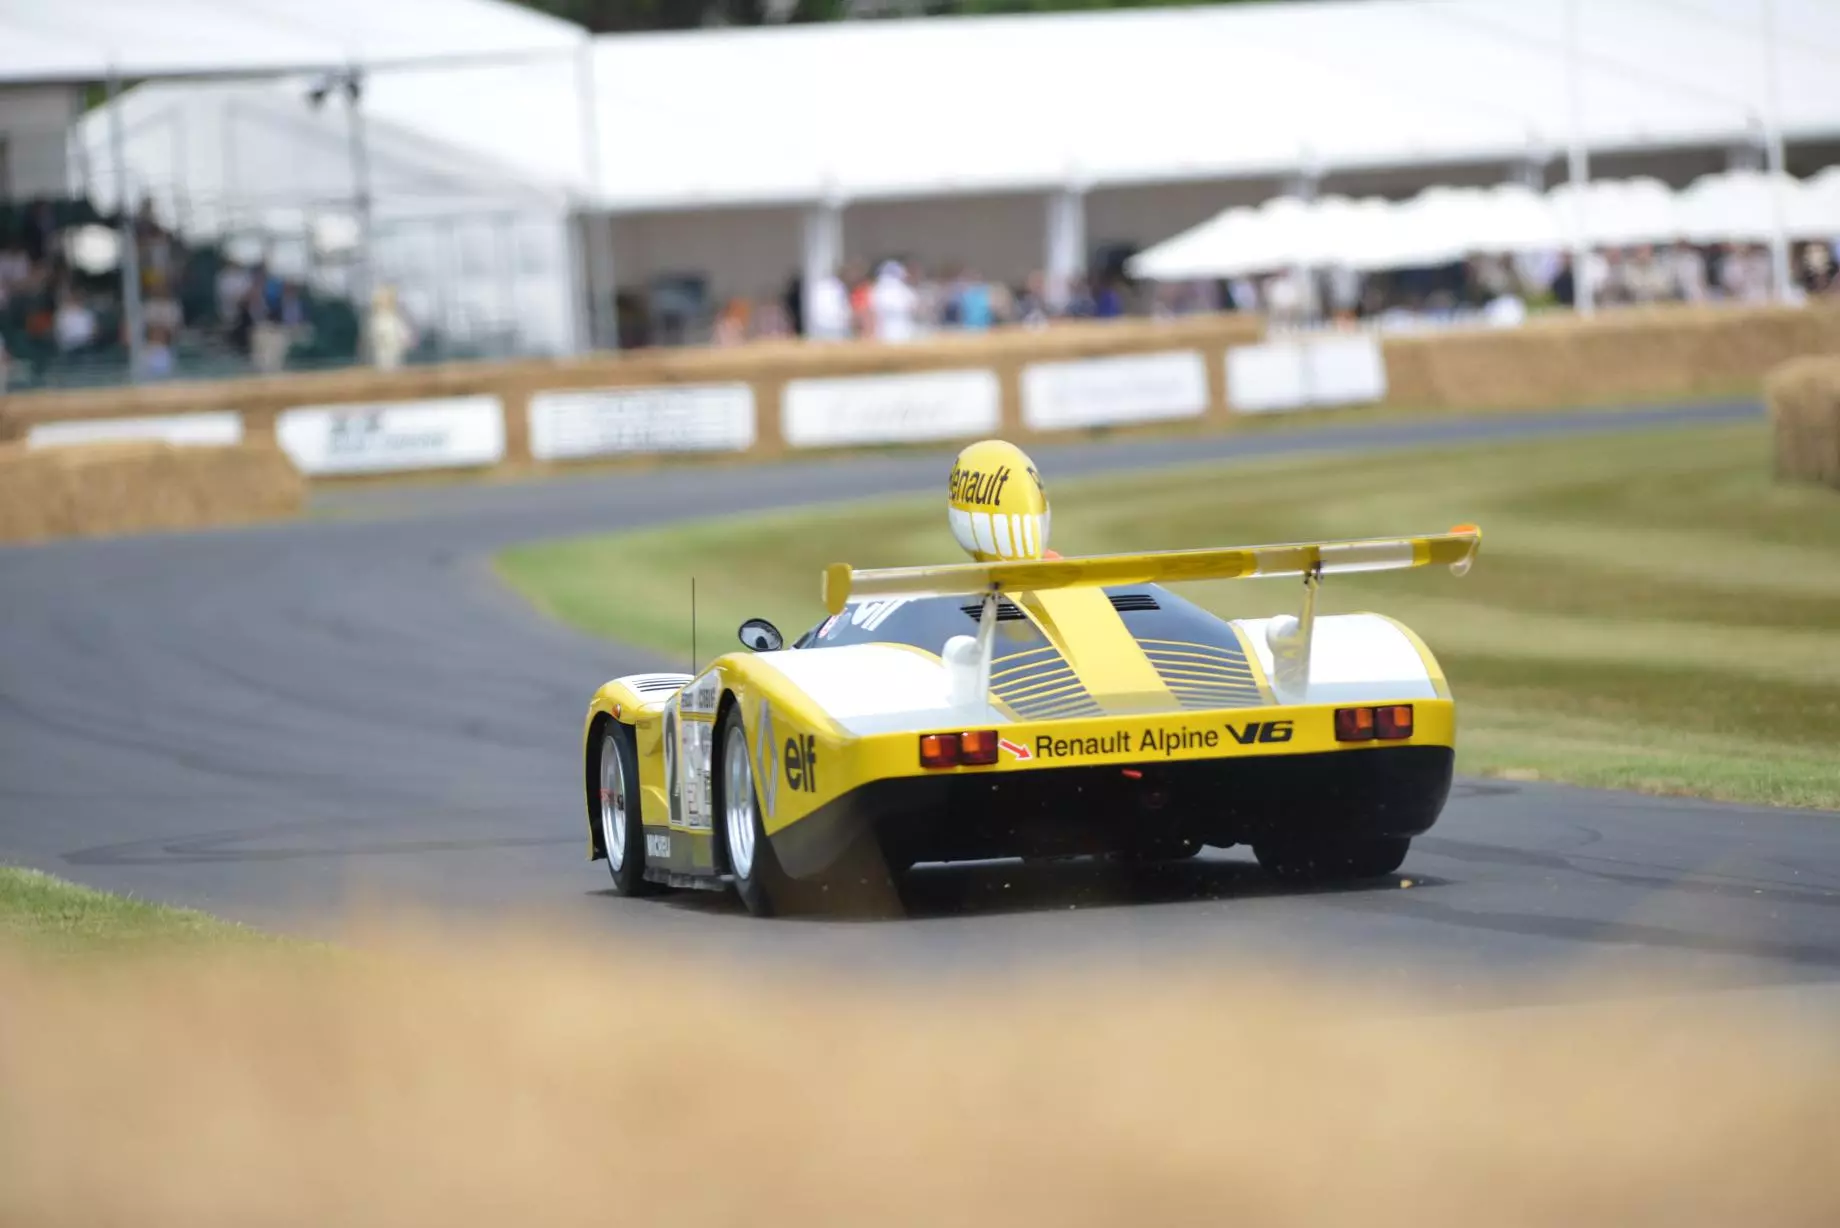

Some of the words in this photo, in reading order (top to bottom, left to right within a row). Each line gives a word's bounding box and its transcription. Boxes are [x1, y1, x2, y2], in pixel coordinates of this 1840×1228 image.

[784, 733, 816, 793] elf
[1035, 731, 1130, 758] Renault
[1139, 726, 1219, 756] Alpine
[1224, 720, 1294, 745] V6
